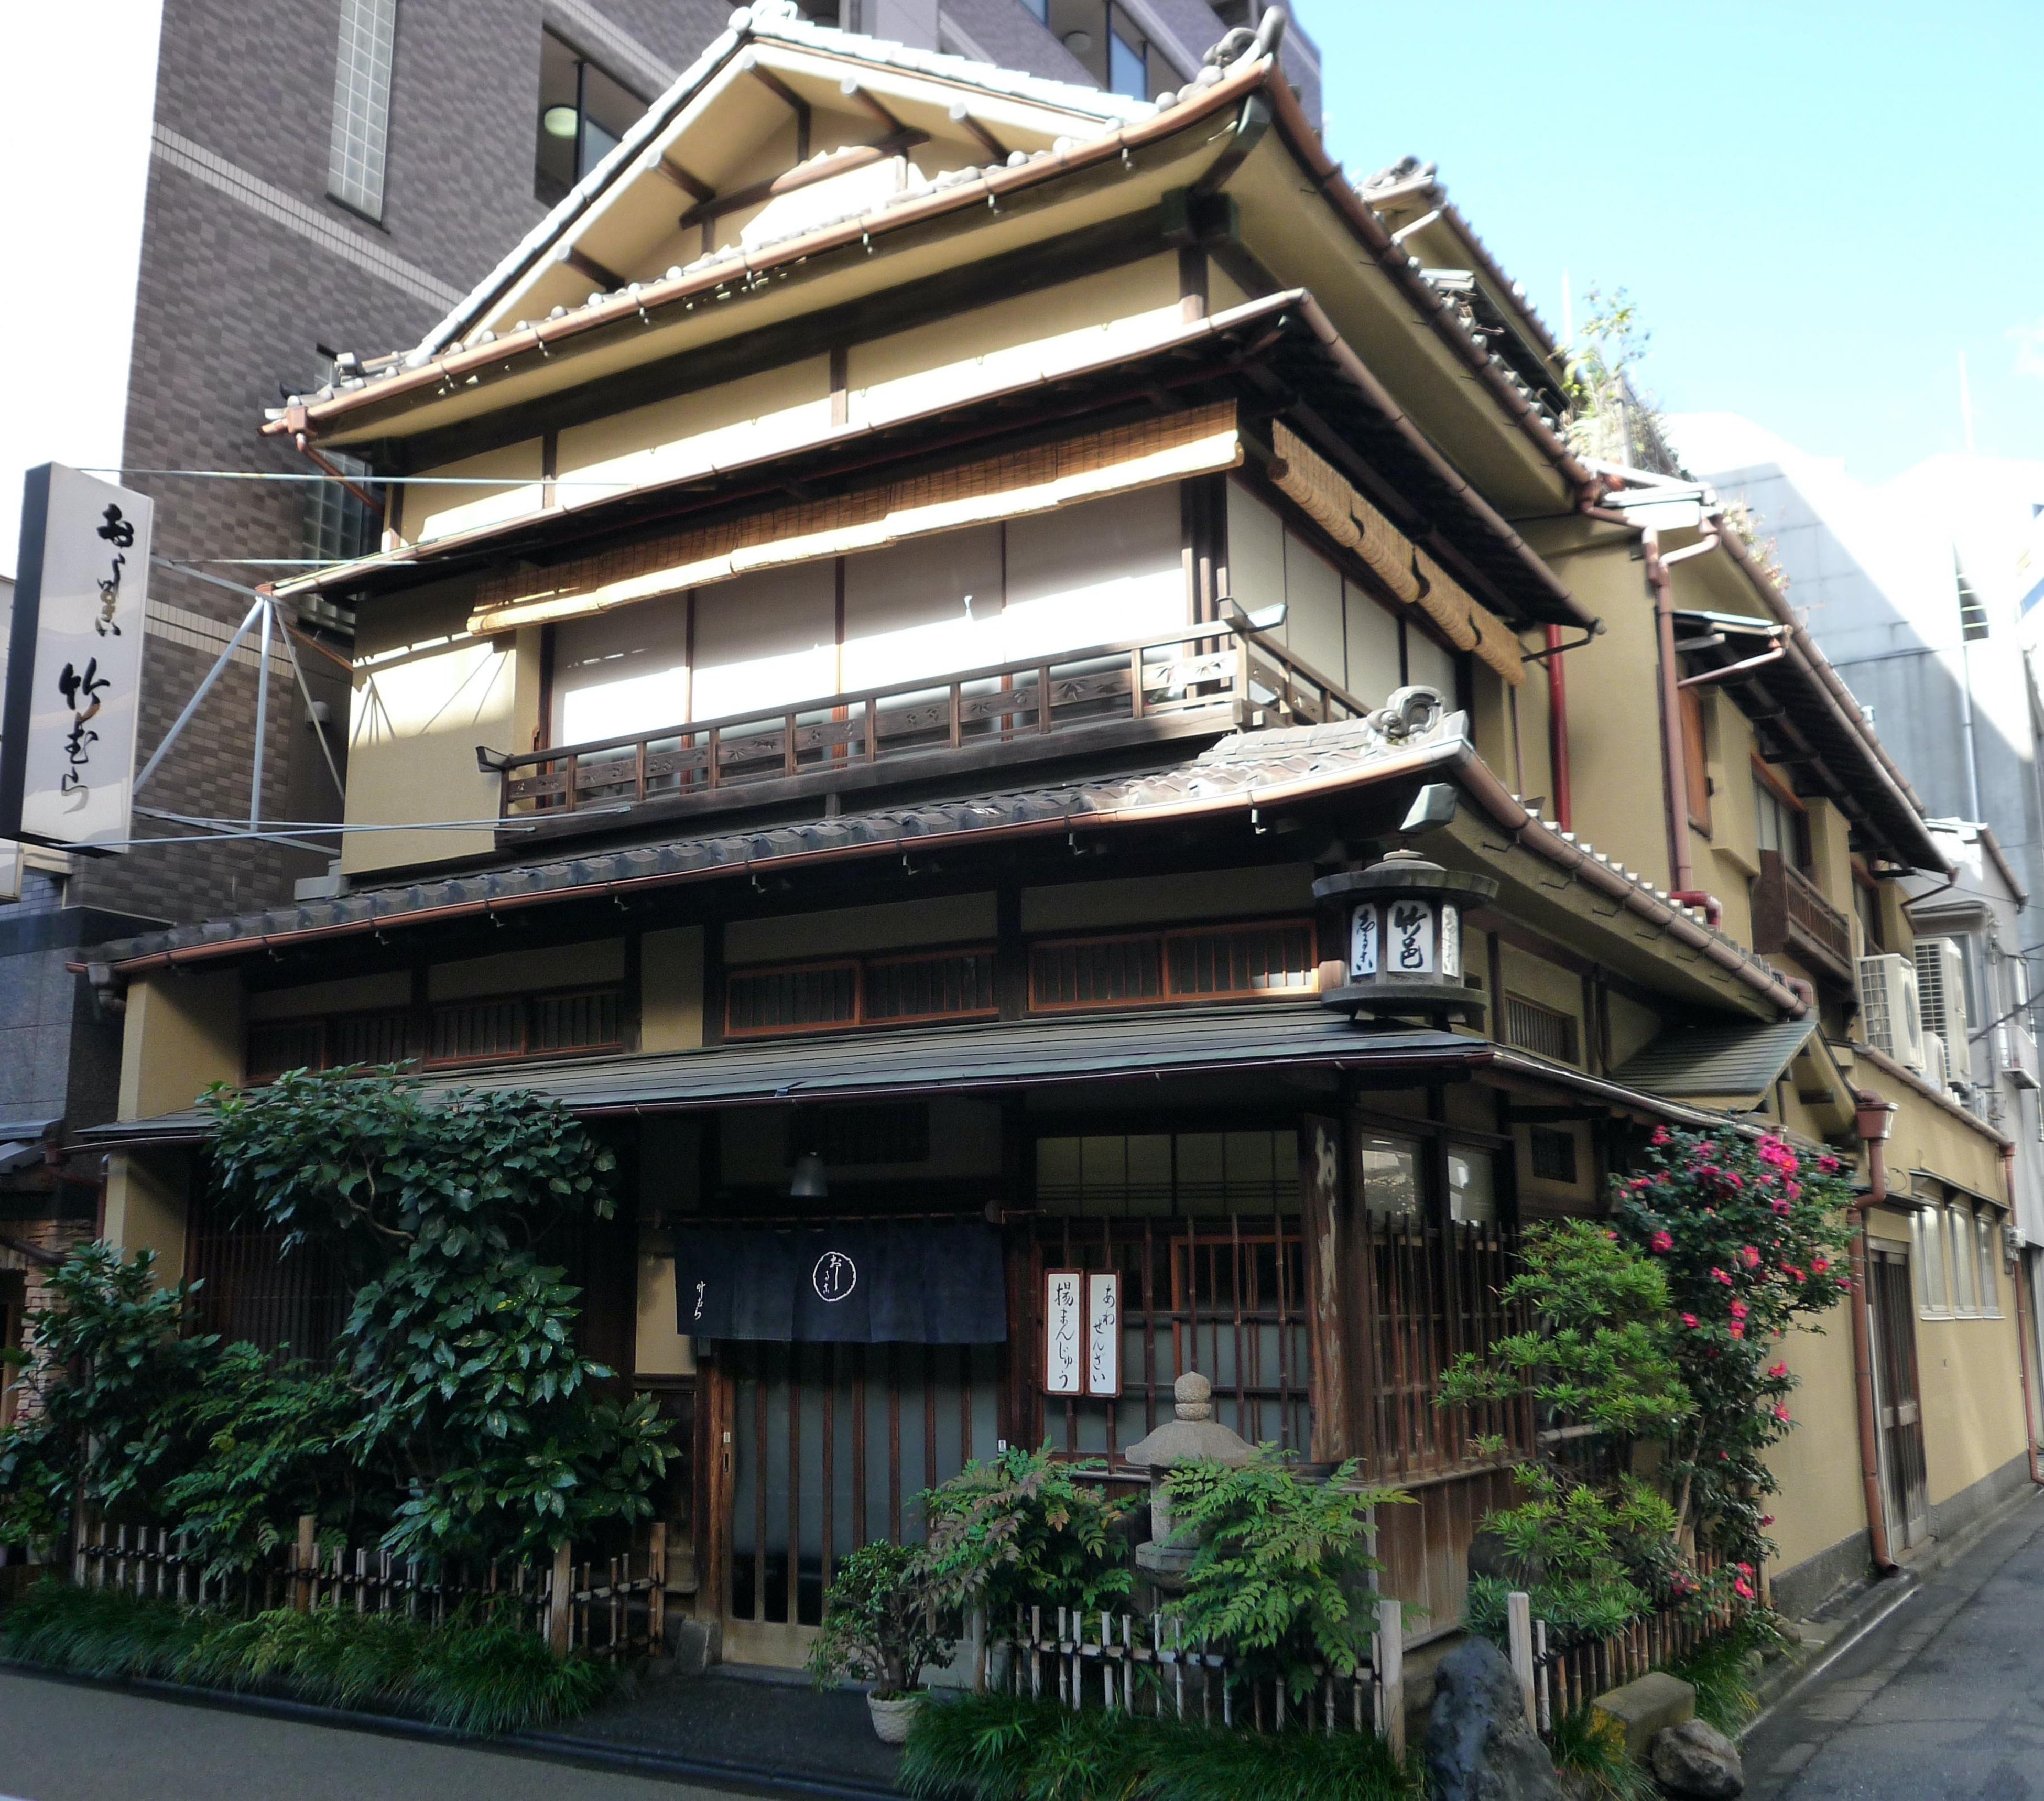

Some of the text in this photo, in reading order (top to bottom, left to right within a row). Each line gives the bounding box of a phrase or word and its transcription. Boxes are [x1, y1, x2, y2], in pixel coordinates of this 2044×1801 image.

[1054, 1281, 1074, 1389] 揚まんじゅう
